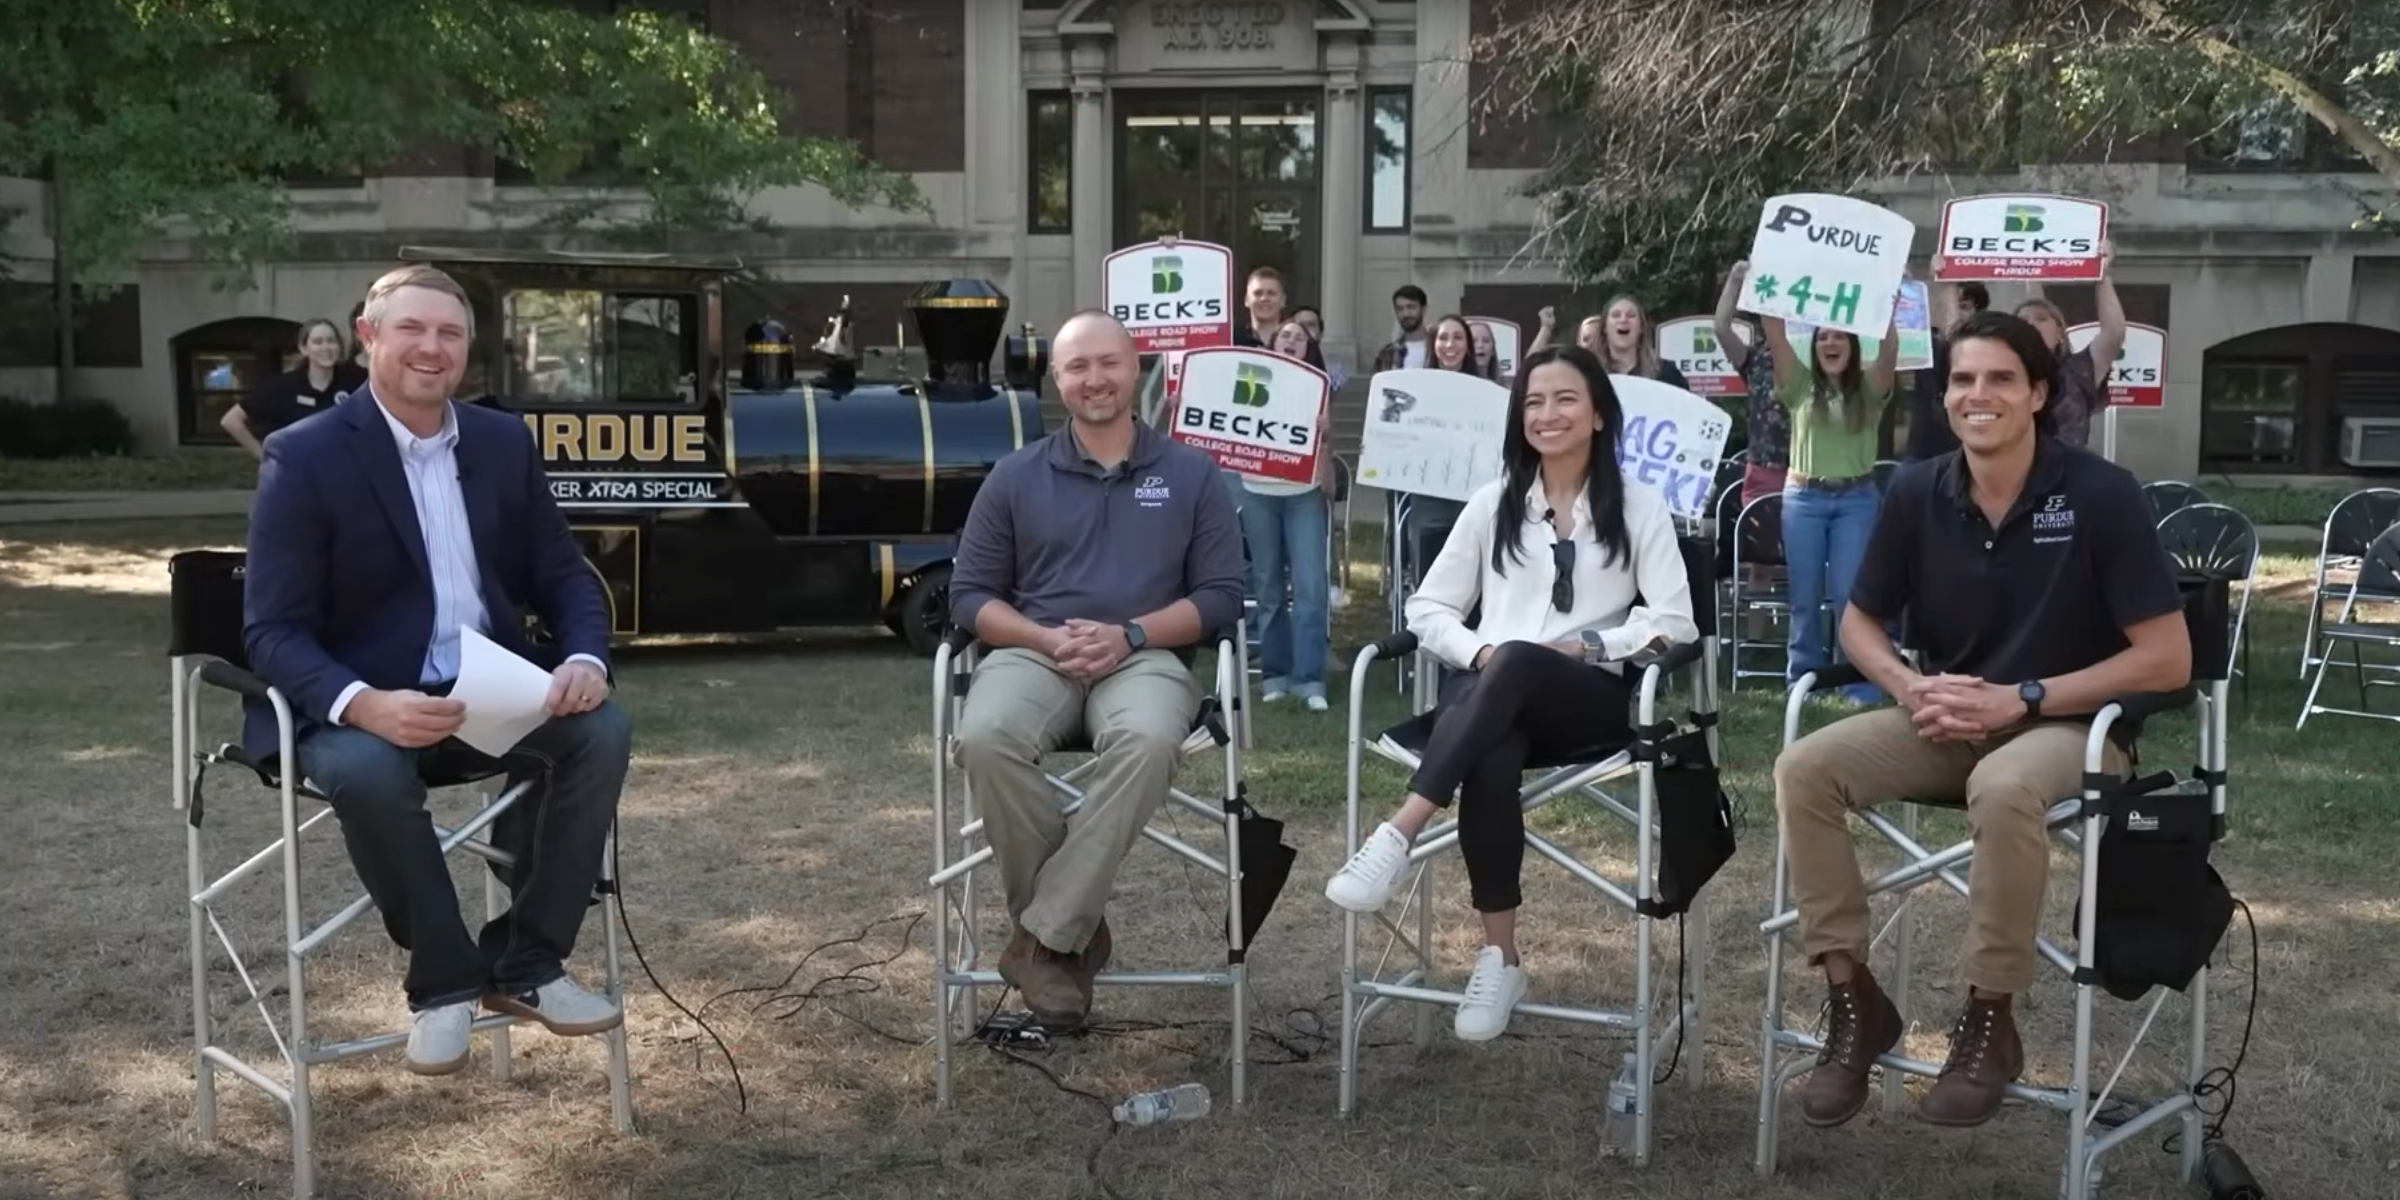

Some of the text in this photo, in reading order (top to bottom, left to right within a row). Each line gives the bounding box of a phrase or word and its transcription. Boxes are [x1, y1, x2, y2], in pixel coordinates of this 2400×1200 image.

[1952, 237, 2091, 252] BECK'S
[1954, 257, 2086, 267] COLLEGE ROAD SHOW
[1993, 267, 2042, 276] PURDUE
[1787, 275, 1861, 325] 4-H
[1113, 299, 1221, 321] BECK'S
[1160, 326, 1188, 337] ROAD
[1190, 325, 1219, 335] SHOW
[1148, 338, 1186, 348] PURDUE
[1183, 406, 1310, 446] BECK'S
[1184, 436, 1302, 465] COLLEGE ROAD SHOW
[1219, 455, 1262, 471] PURDUE
[587, 481, 637, 499] XTRA
[642, 481, 718, 499] SPECIAL
[1135, 487, 1170, 495] PURDUE
[2033, 510, 2074, 524] PURDUE
